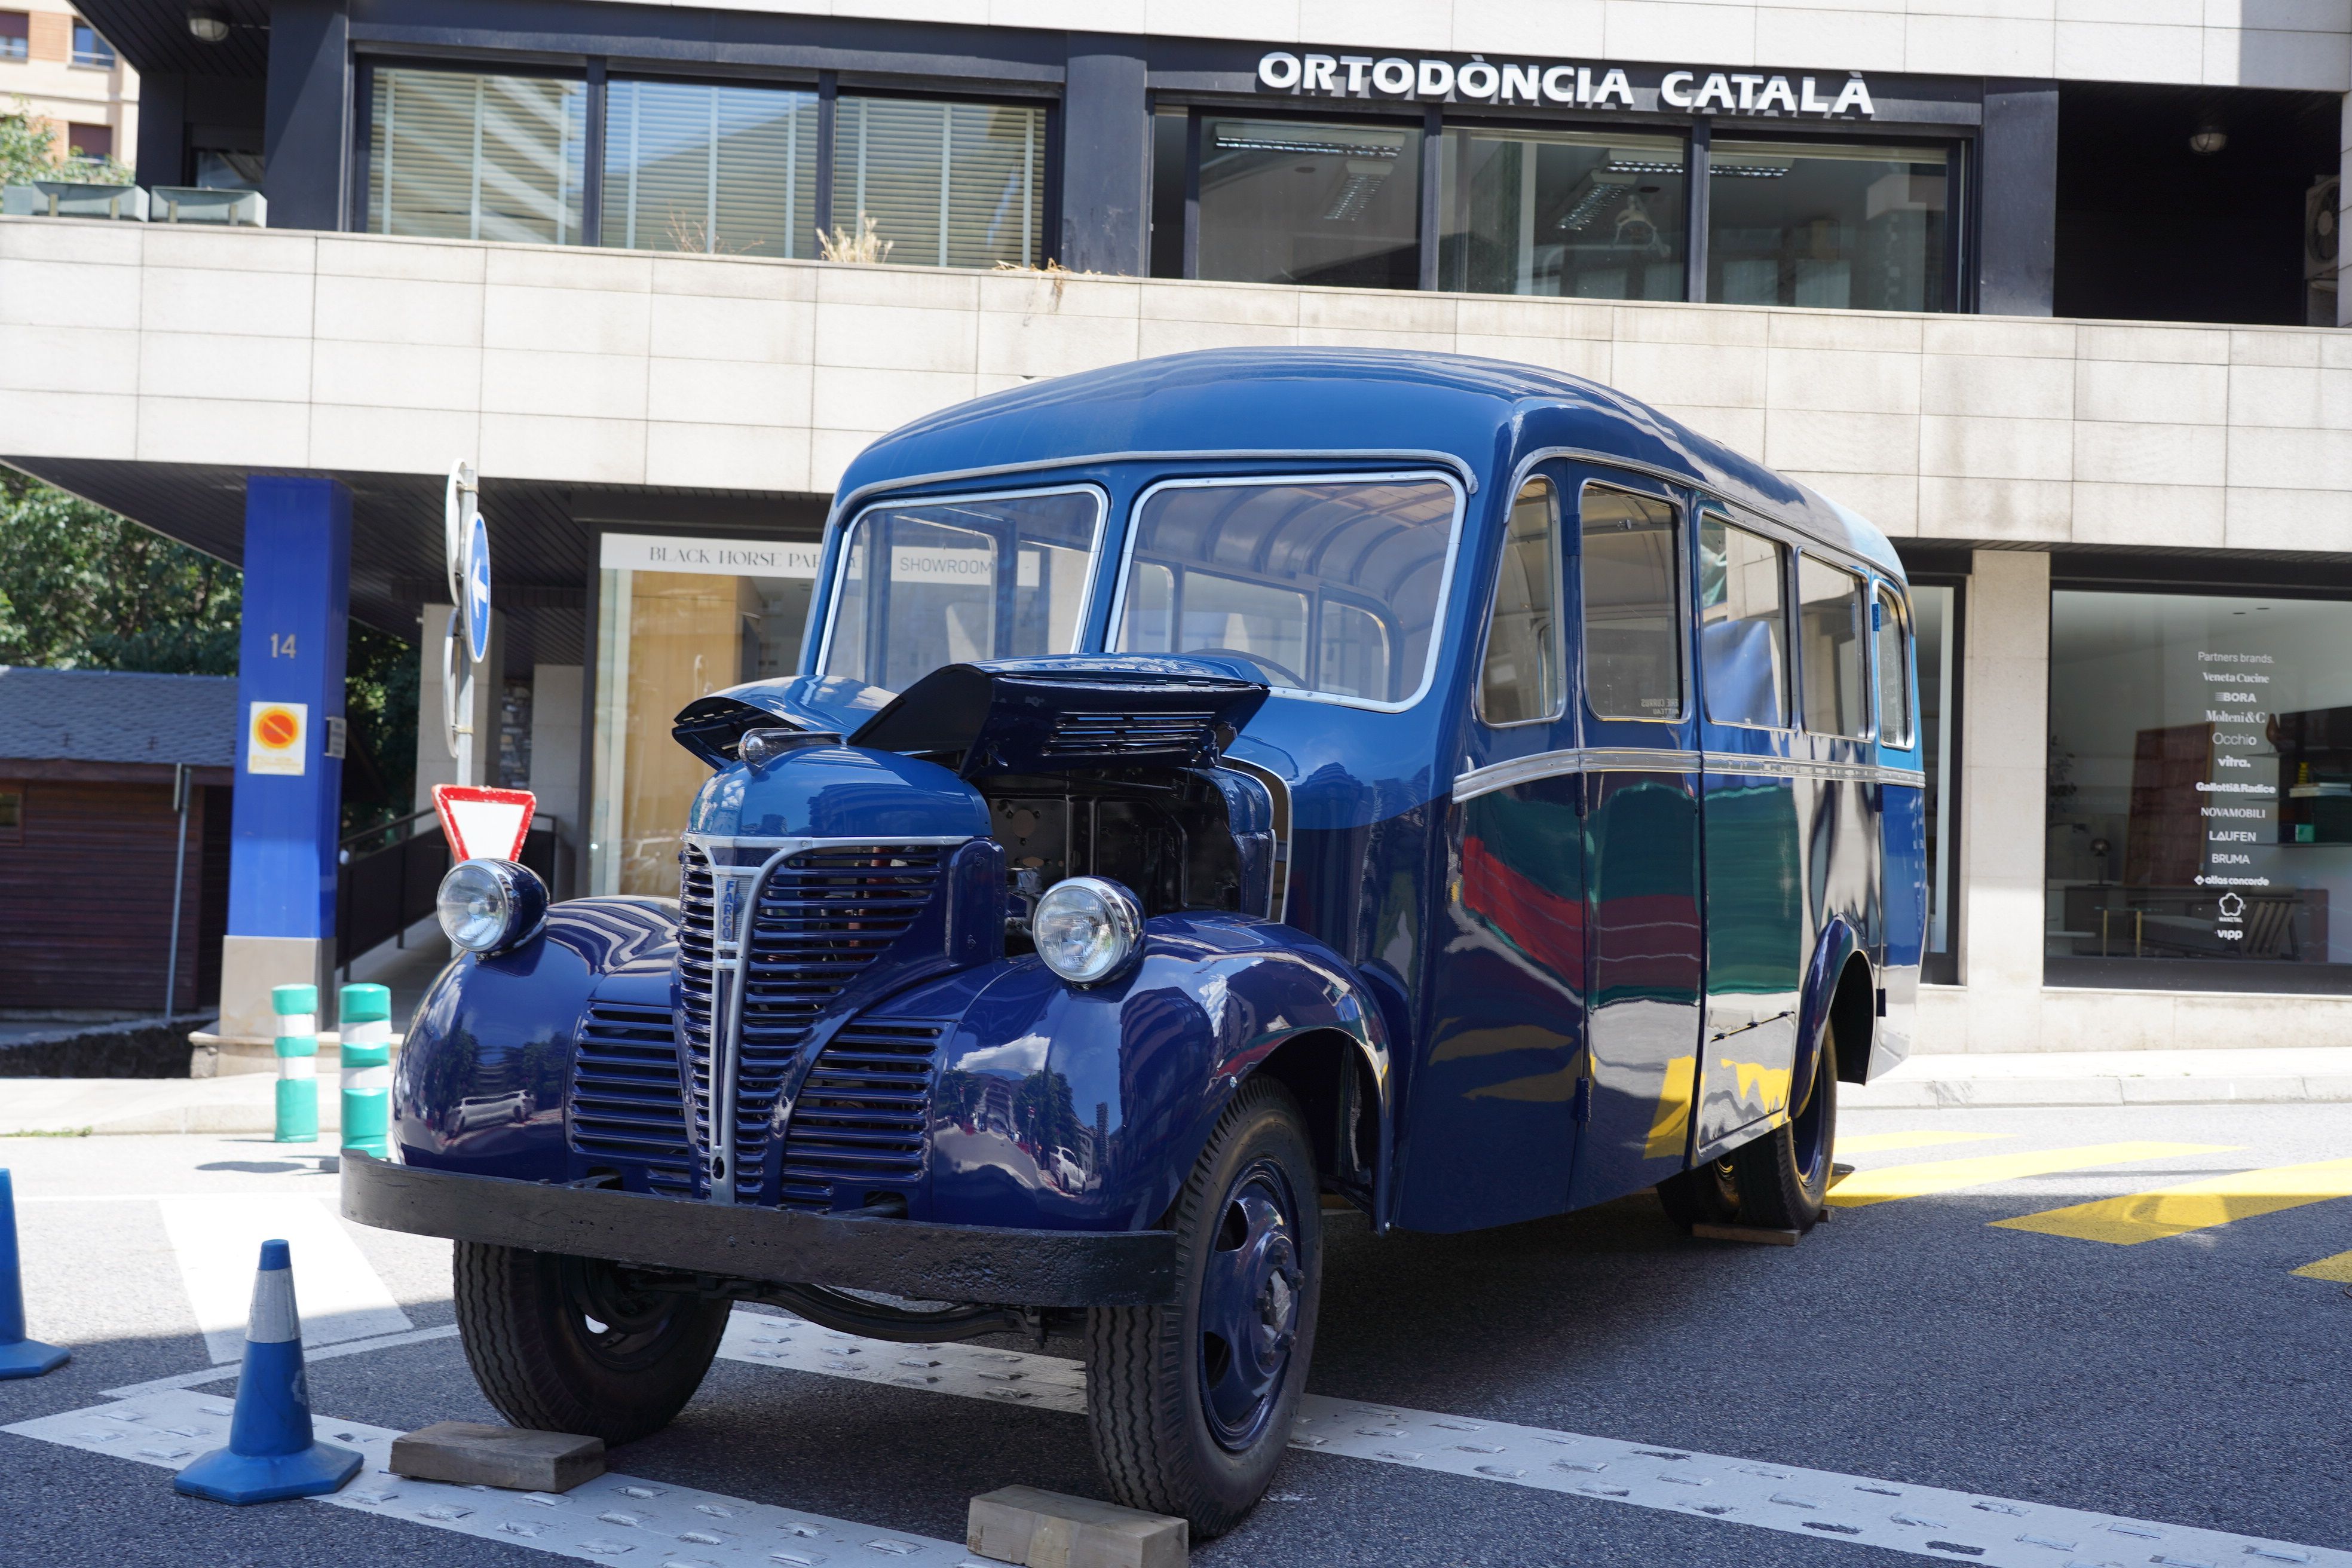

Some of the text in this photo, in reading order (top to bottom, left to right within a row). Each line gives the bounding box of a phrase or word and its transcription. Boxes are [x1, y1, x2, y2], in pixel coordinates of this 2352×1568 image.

[1258, 51, 1875, 114] ORTODÒNCIA CATALÀ
[650, 547, 710, 564] BLACK
[719, 550, 782, 566] HORSE
[900, 558, 994, 574] SHOWROOM
[271, 633, 297, 659] 14
[2198, 651, 2274, 663] Partners brands.
[2203, 672, 2270, 683] Veneta Cucine
[2223, 693, 2256, 703] BORA
[2212, 732, 2257, 746] Occhio
[2201, 807, 2265, 819] NOVAMOBILI
[2209, 831, 2256, 842] LAUFEN
[2212, 853, 2250, 865] BRUMA
[2204, 875, 2270, 886] atlas concorde
[722, 880, 736, 939] FARGO
[2217, 930, 2243, 941] vipp
